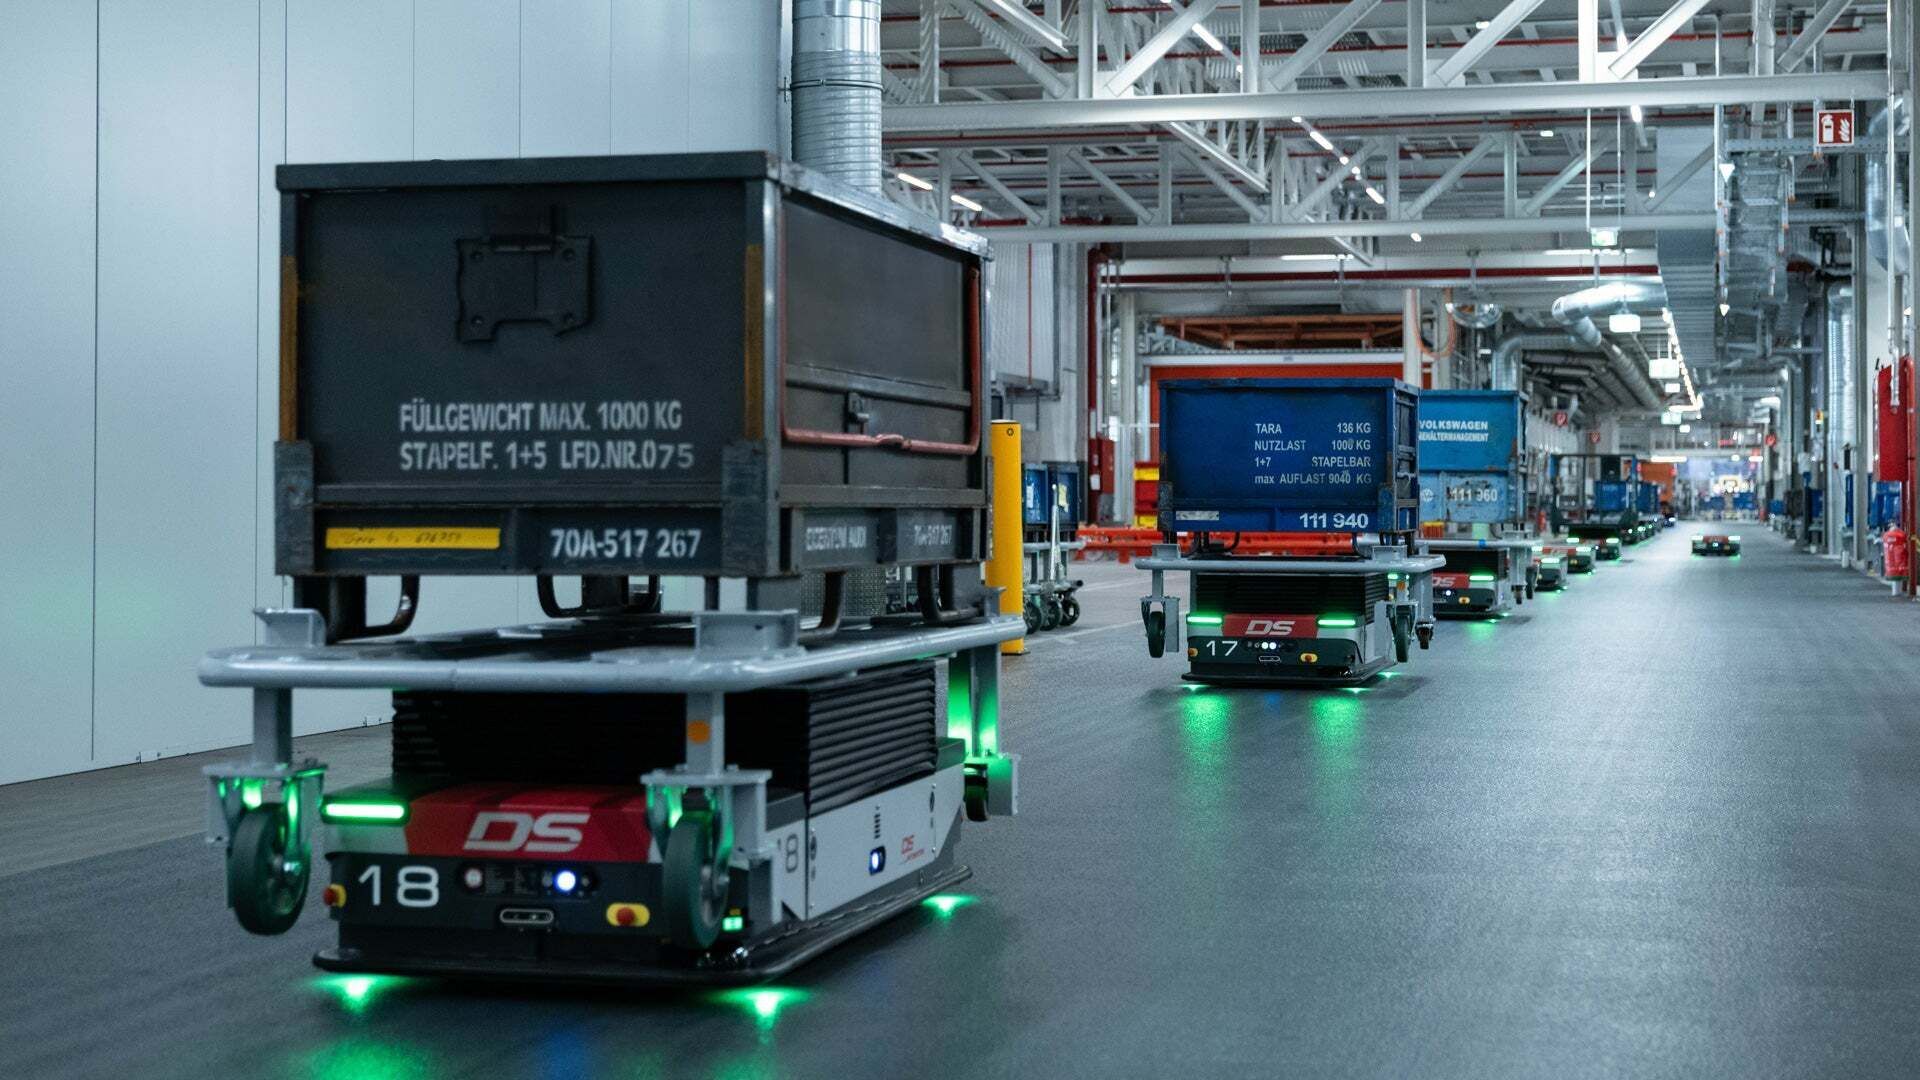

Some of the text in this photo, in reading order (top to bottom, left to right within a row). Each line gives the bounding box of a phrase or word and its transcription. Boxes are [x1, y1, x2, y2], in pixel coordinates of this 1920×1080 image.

[400, 398, 682, 432] FÜLLGEWICHT MAX. 1000 KG
[1255, 422, 1371, 434] TARA 136 KG
[1419, 419, 1489, 430] VOLKSWAGEN
[1254, 439, 1371, 451] NUTZLAST 1000 KG
[400, 441, 499, 471] STAPELF.
[506, 441, 547, 469] 1+5
[1254, 456, 1371, 467] 1+7 STAPELBAR
[1254, 472, 1372, 484] max AUFLAST 9040 KG
[1300, 512, 1369, 529] 111 940
[550, 528, 701, 559] 70A-517 267
[1245, 619, 1296, 636] DS
[1205, 640, 1239, 657] 17
[464, 811, 591, 853] DS
[358, 864, 440, 908] 18
